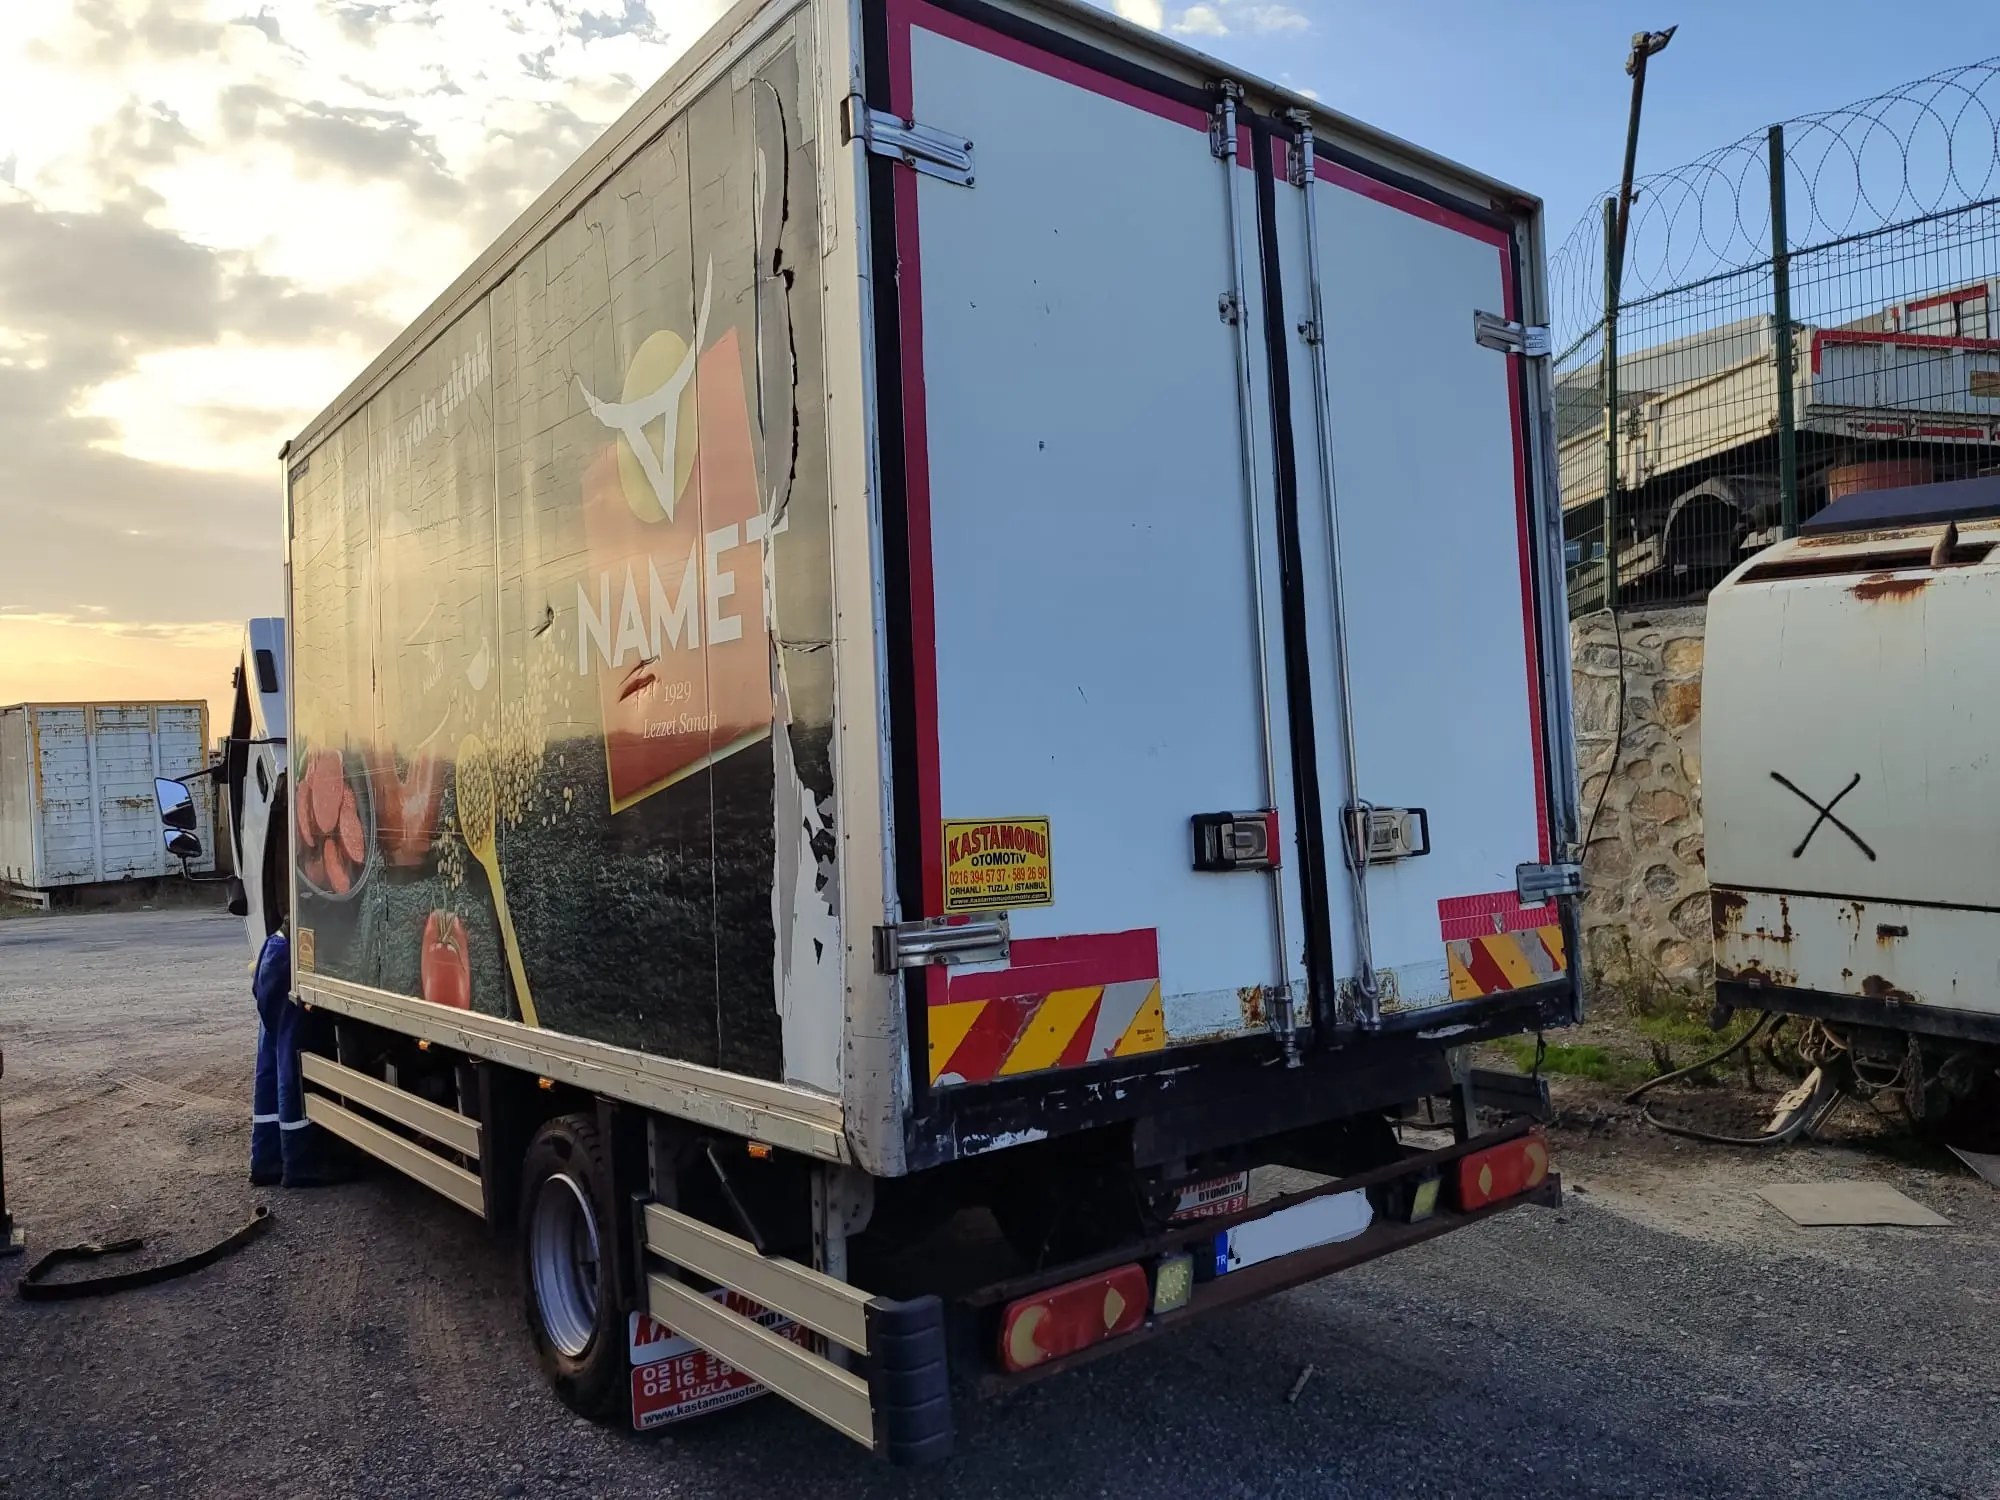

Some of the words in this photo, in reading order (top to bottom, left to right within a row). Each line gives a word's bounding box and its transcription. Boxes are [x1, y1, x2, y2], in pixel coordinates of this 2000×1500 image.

[577, 506, 788, 676] NAMET
[663, 681, 692, 706] 1929
[643, 715, 677, 739] Lezzet
[948, 825, 1047, 867] KASTAMONU
[949, 870, 969, 886] 0216
[970, 869, 984, 884] 394
[985, 869, 995, 883] 57
[997, 868, 1006, 882] 37
[1012, 867, 1025, 881] 589
[1027, 867, 1036, 880] 26
[950, 886, 982, 896] ORHANLI
[988, 884, 1010, 893] TUZLA
[1216, 1201, 1230, 1215] 57
[1231, 1196, 1244, 1209] 37
[1215, 1254, 1227, 1267] TR
[679, 1380, 732, 1401] TUZLA
[643, 1384, 765, 1425] www.kastamonuotom
